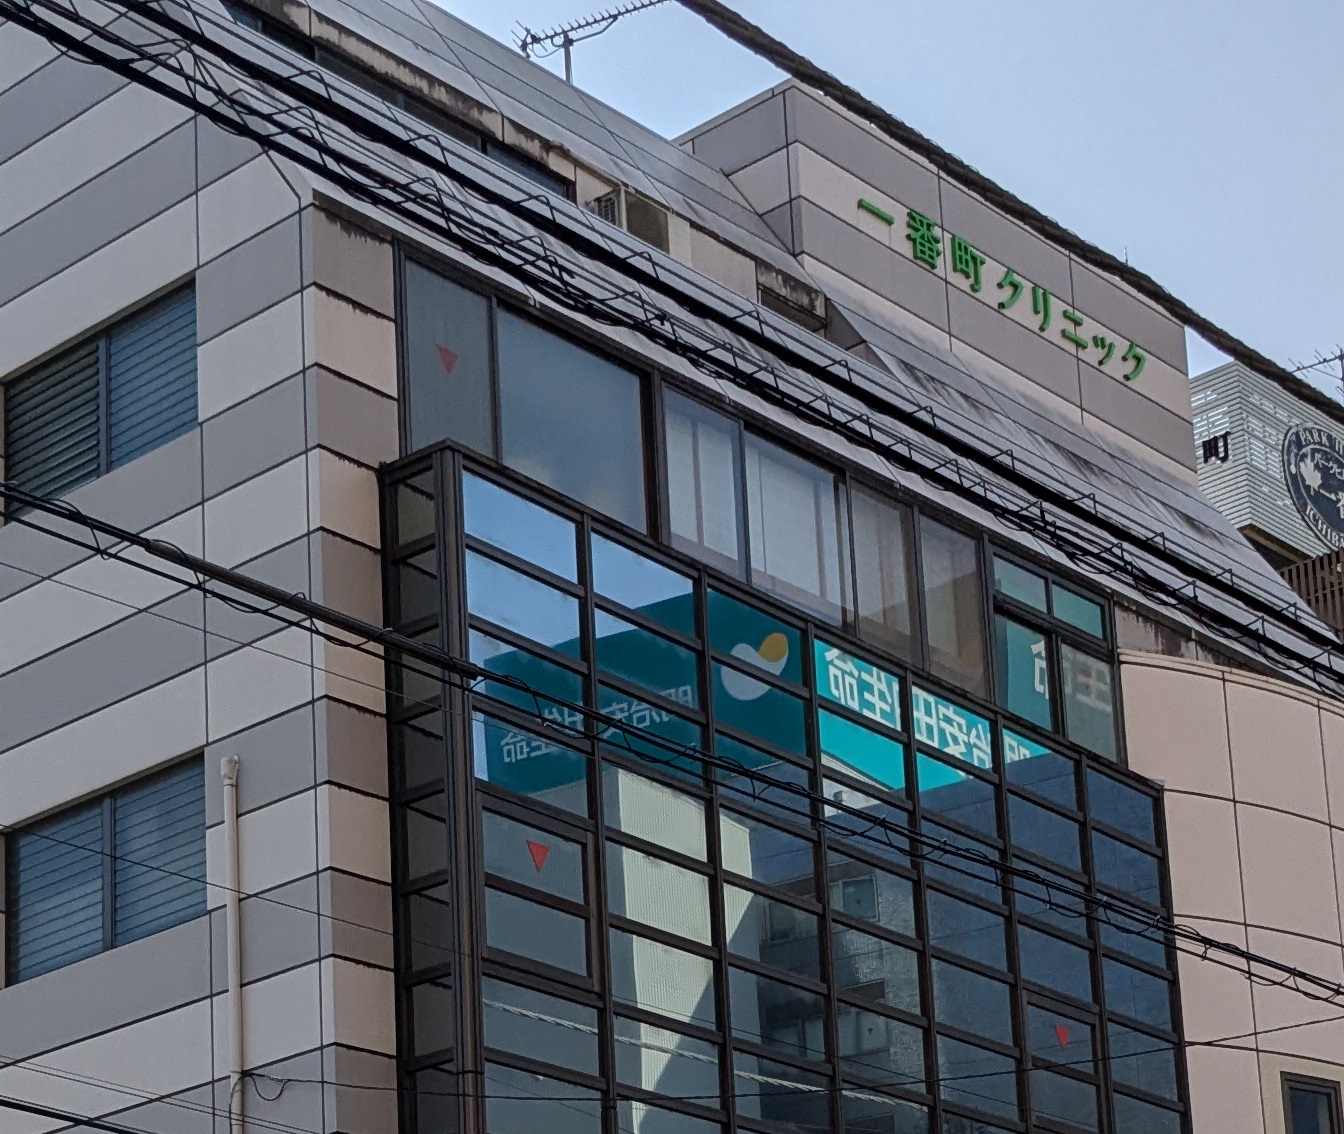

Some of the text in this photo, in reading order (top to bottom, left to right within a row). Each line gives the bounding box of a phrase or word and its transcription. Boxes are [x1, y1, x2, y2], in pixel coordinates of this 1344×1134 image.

[857, 197, 1149, 382] 一番町クリニック
[1299, 428, 1329, 446] PARK
